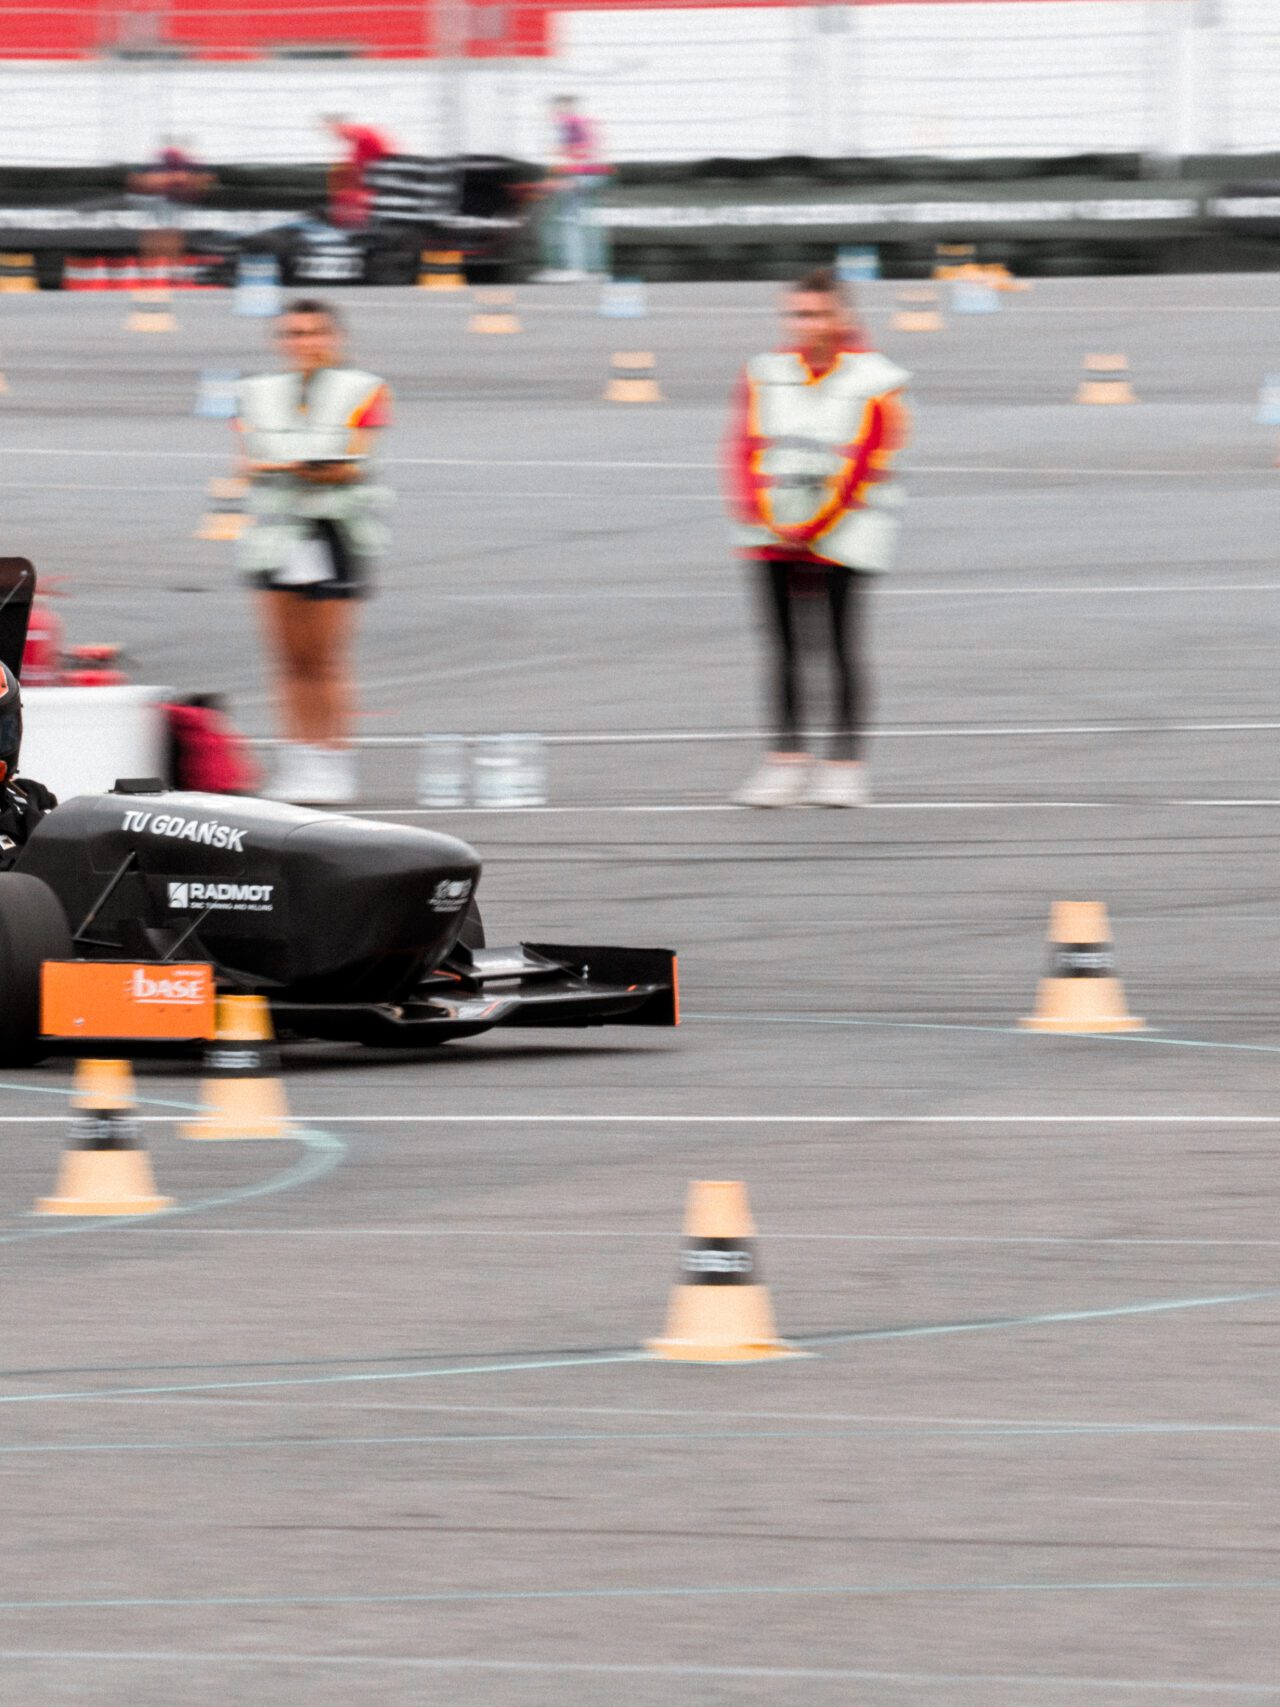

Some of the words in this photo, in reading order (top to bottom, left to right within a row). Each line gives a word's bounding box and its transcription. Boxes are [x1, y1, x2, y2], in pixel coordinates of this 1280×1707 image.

[122, 810, 152, 833] TU
[149, 815, 248, 852] GDAŃSK
[189, 883, 275, 902] RADMOT
